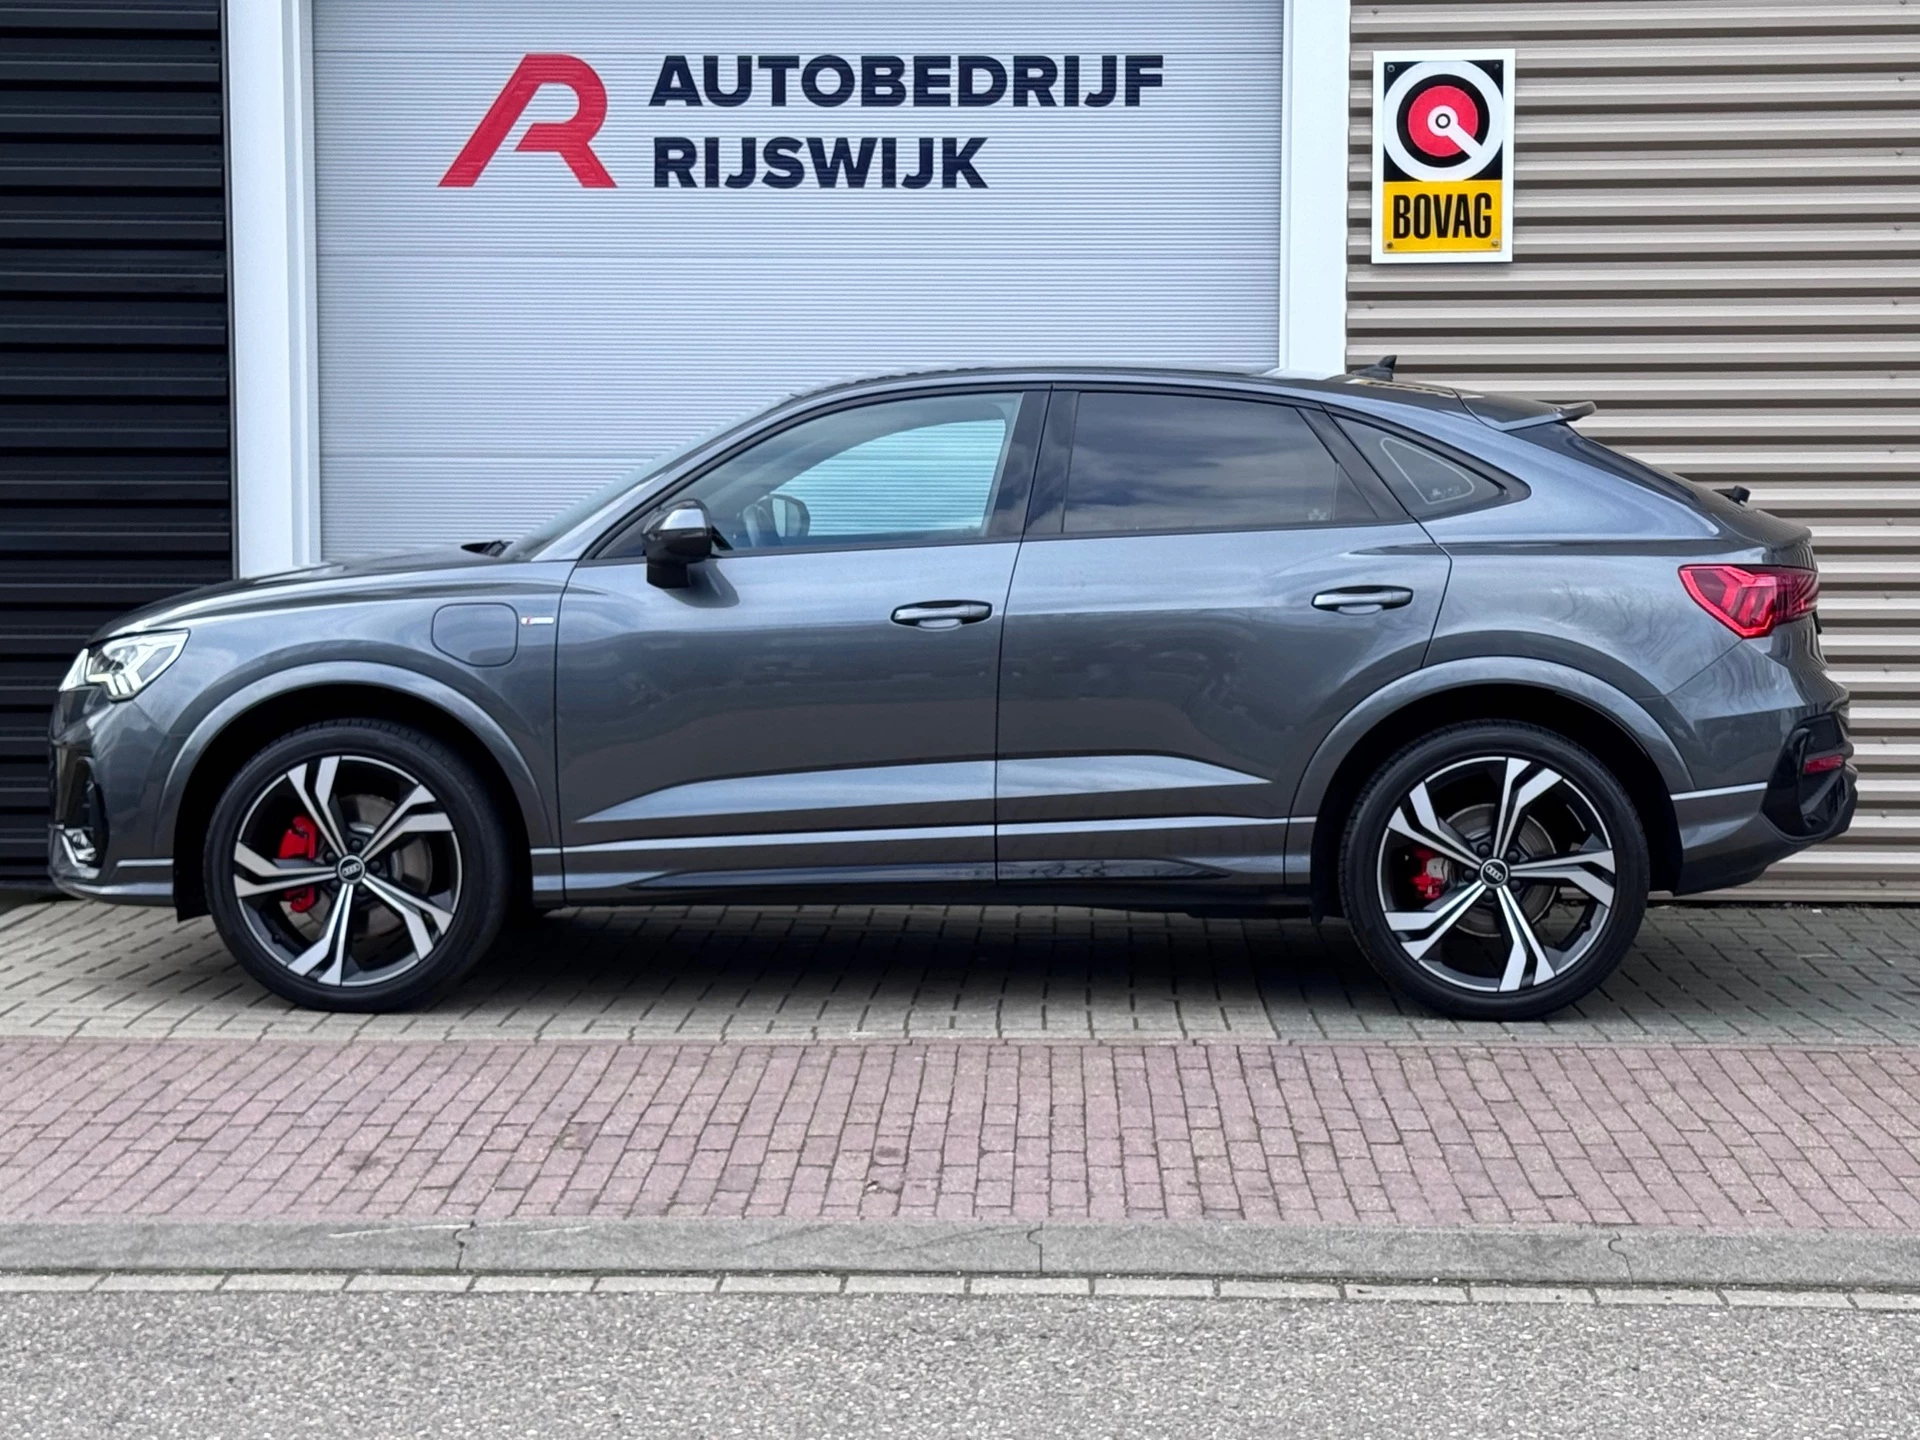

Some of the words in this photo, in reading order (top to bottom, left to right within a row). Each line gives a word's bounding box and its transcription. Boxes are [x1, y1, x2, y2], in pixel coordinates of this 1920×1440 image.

[649, 54, 1164, 108] AUTOBEDRIJF
[653, 136, 989, 190] RIJSWIJK
[1393, 193, 1492, 239] BOVAG
